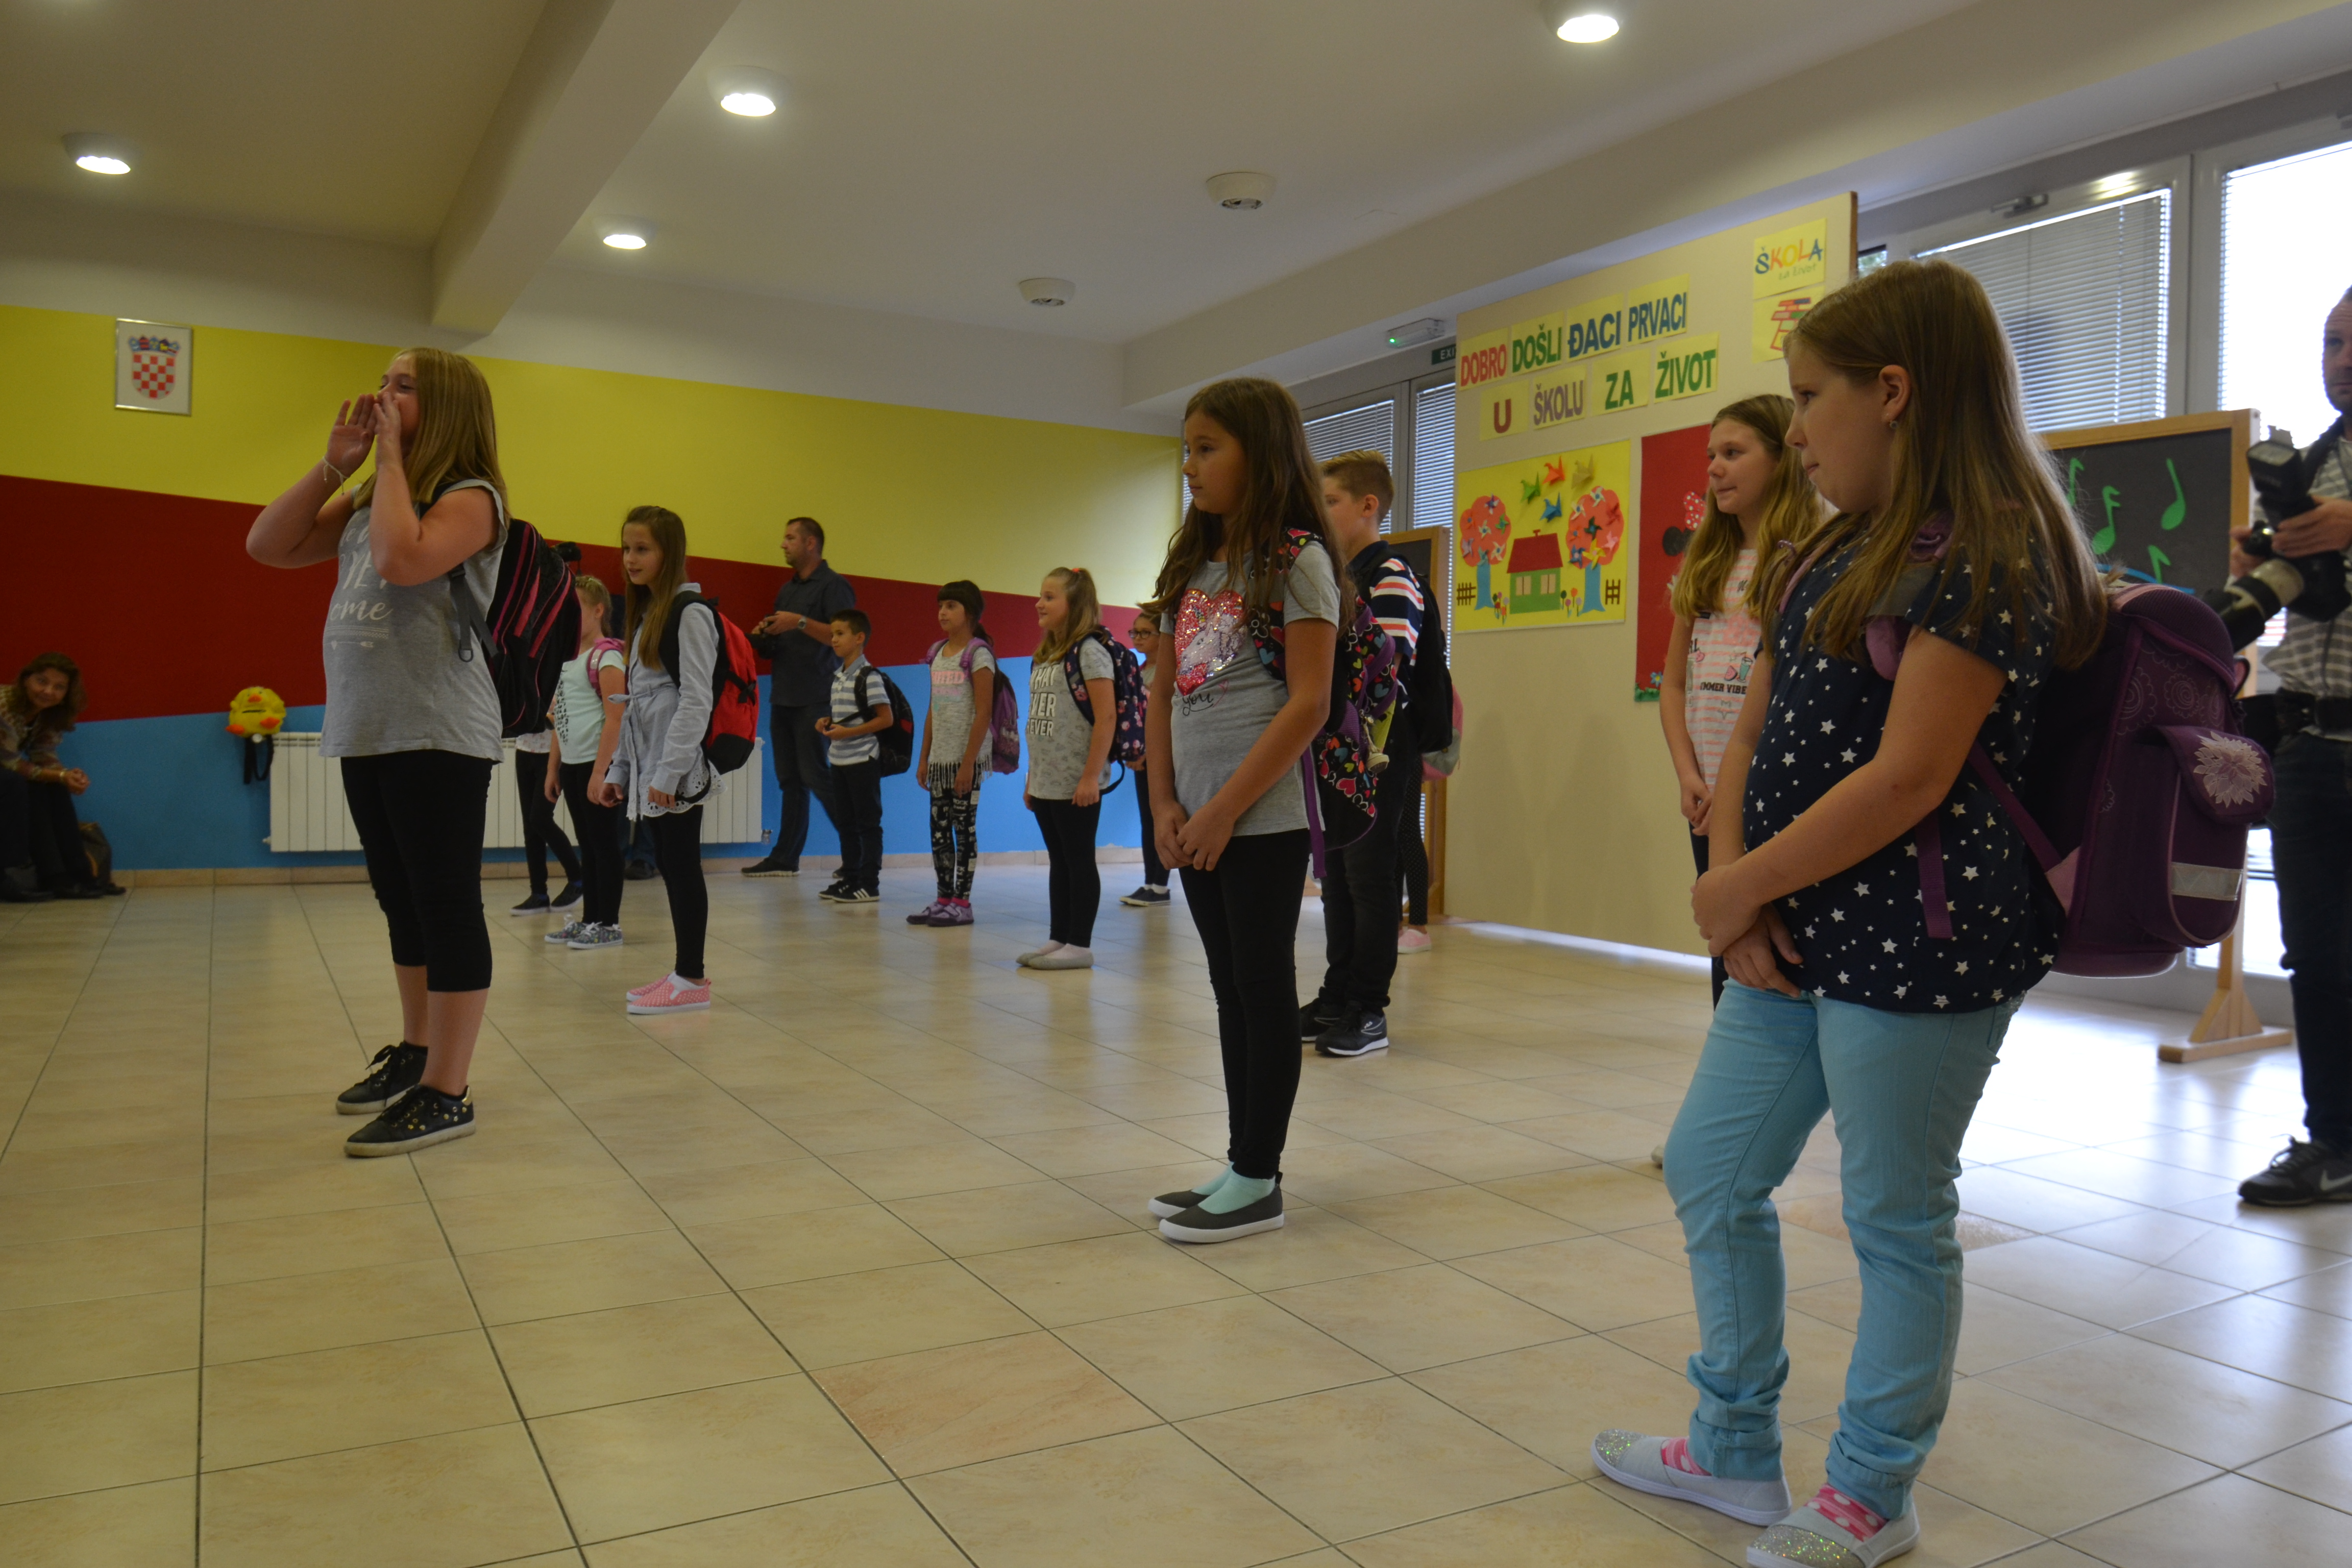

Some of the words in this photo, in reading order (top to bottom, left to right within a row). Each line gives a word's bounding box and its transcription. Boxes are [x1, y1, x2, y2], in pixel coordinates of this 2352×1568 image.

[1755, 238, 1823, 275] ŠKOLA
[1440, 347, 1454, 360] EXI
[1460, 344, 1507, 387] DOBRO
[1512, 325, 1562, 373] DOŠLI
[1567, 310, 1621, 358] ĐACI
[1628, 292, 1686, 342] PRVACI
[1493, 399, 1511, 433] U
[1534, 380, 1584, 426] ŠKOLU
[1605, 370, 1634, 410] ZA
[1655, 349, 1716, 399] ŽIVOT
[1182, 693, 1214, 716] you
[1727, 684, 1747, 695] VIBE
